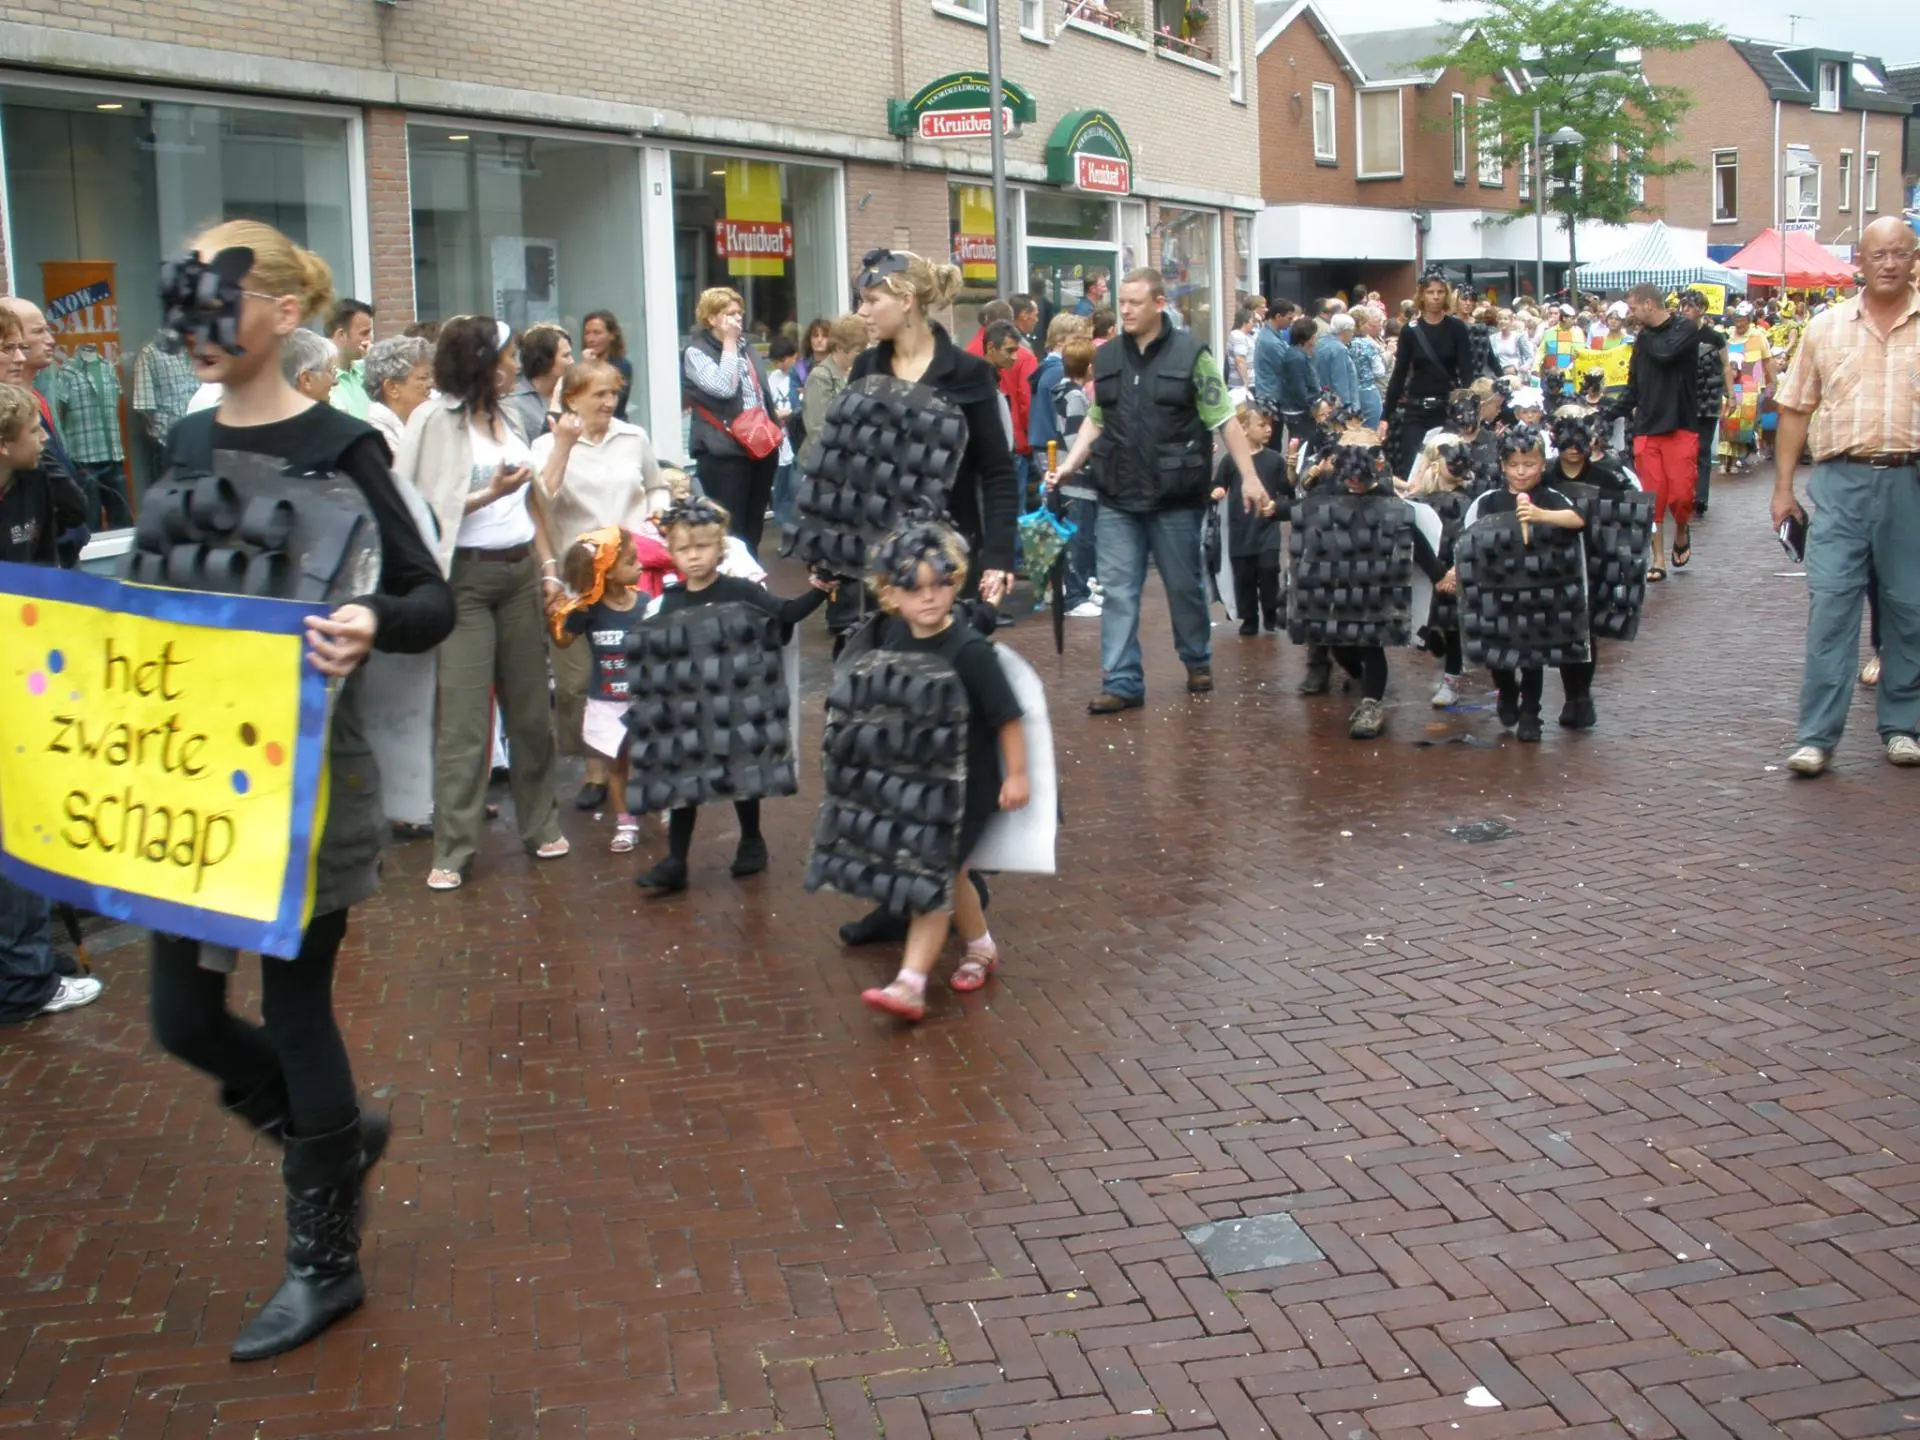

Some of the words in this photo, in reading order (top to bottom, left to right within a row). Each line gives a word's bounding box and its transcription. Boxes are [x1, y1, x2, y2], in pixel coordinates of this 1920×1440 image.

[933, 114, 991, 133] Kruidva
[1088, 161, 1119, 186] Kruidvat
[726, 223, 784, 253] Kruidvat
[961, 236, 996, 260] Kruidva
[104, 637, 193, 701] het
[46, 713, 209, 777] zwarte
[61, 786, 235, 893] schaap
